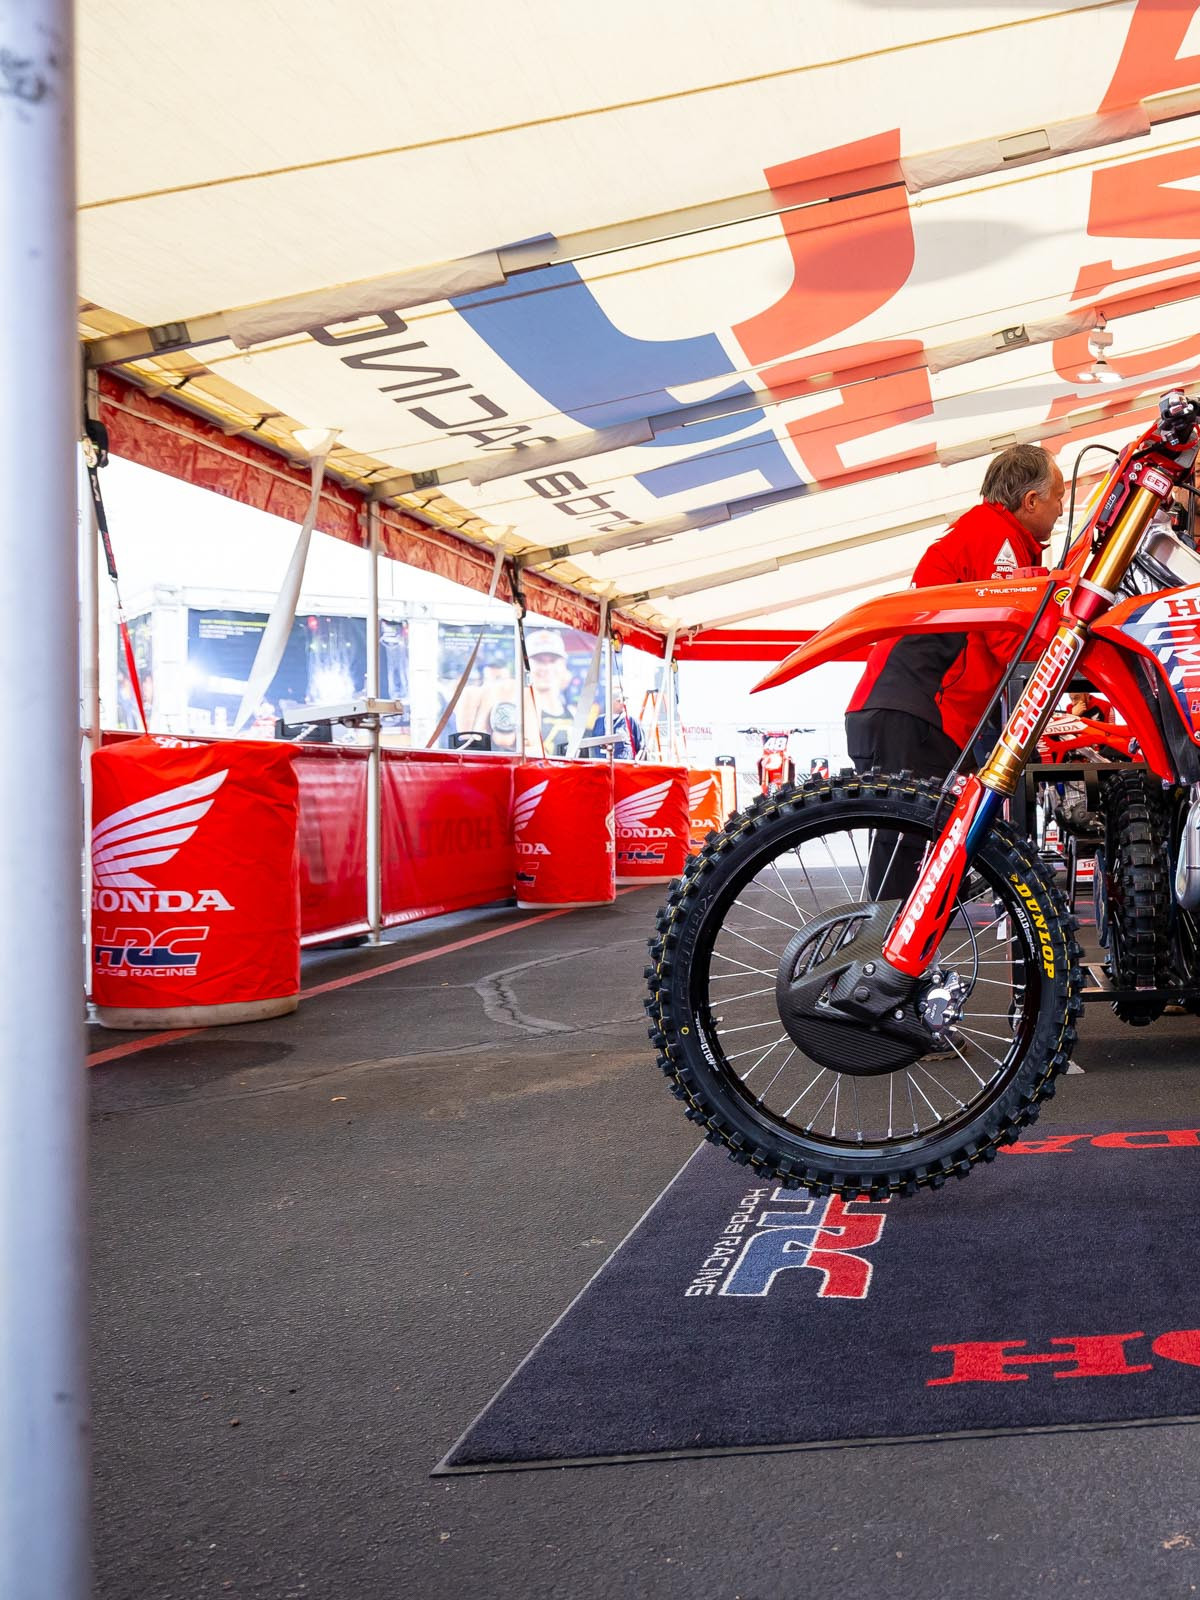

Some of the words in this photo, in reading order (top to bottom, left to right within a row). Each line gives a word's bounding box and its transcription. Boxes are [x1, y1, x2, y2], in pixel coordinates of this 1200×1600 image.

[1147, 475, 1167, 490] GET
[989, 586, 1037, 594] TRUETIMBER
[1008, 635, 1074, 749] SHOWA
[898, 817, 962, 945] DUNLOP
[1015, 883, 1055, 979] DUNLOP
[130, 967, 197, 977] RACING
[723, 1188, 769, 1235] Honda
[684, 1236, 743, 1297] RACING
